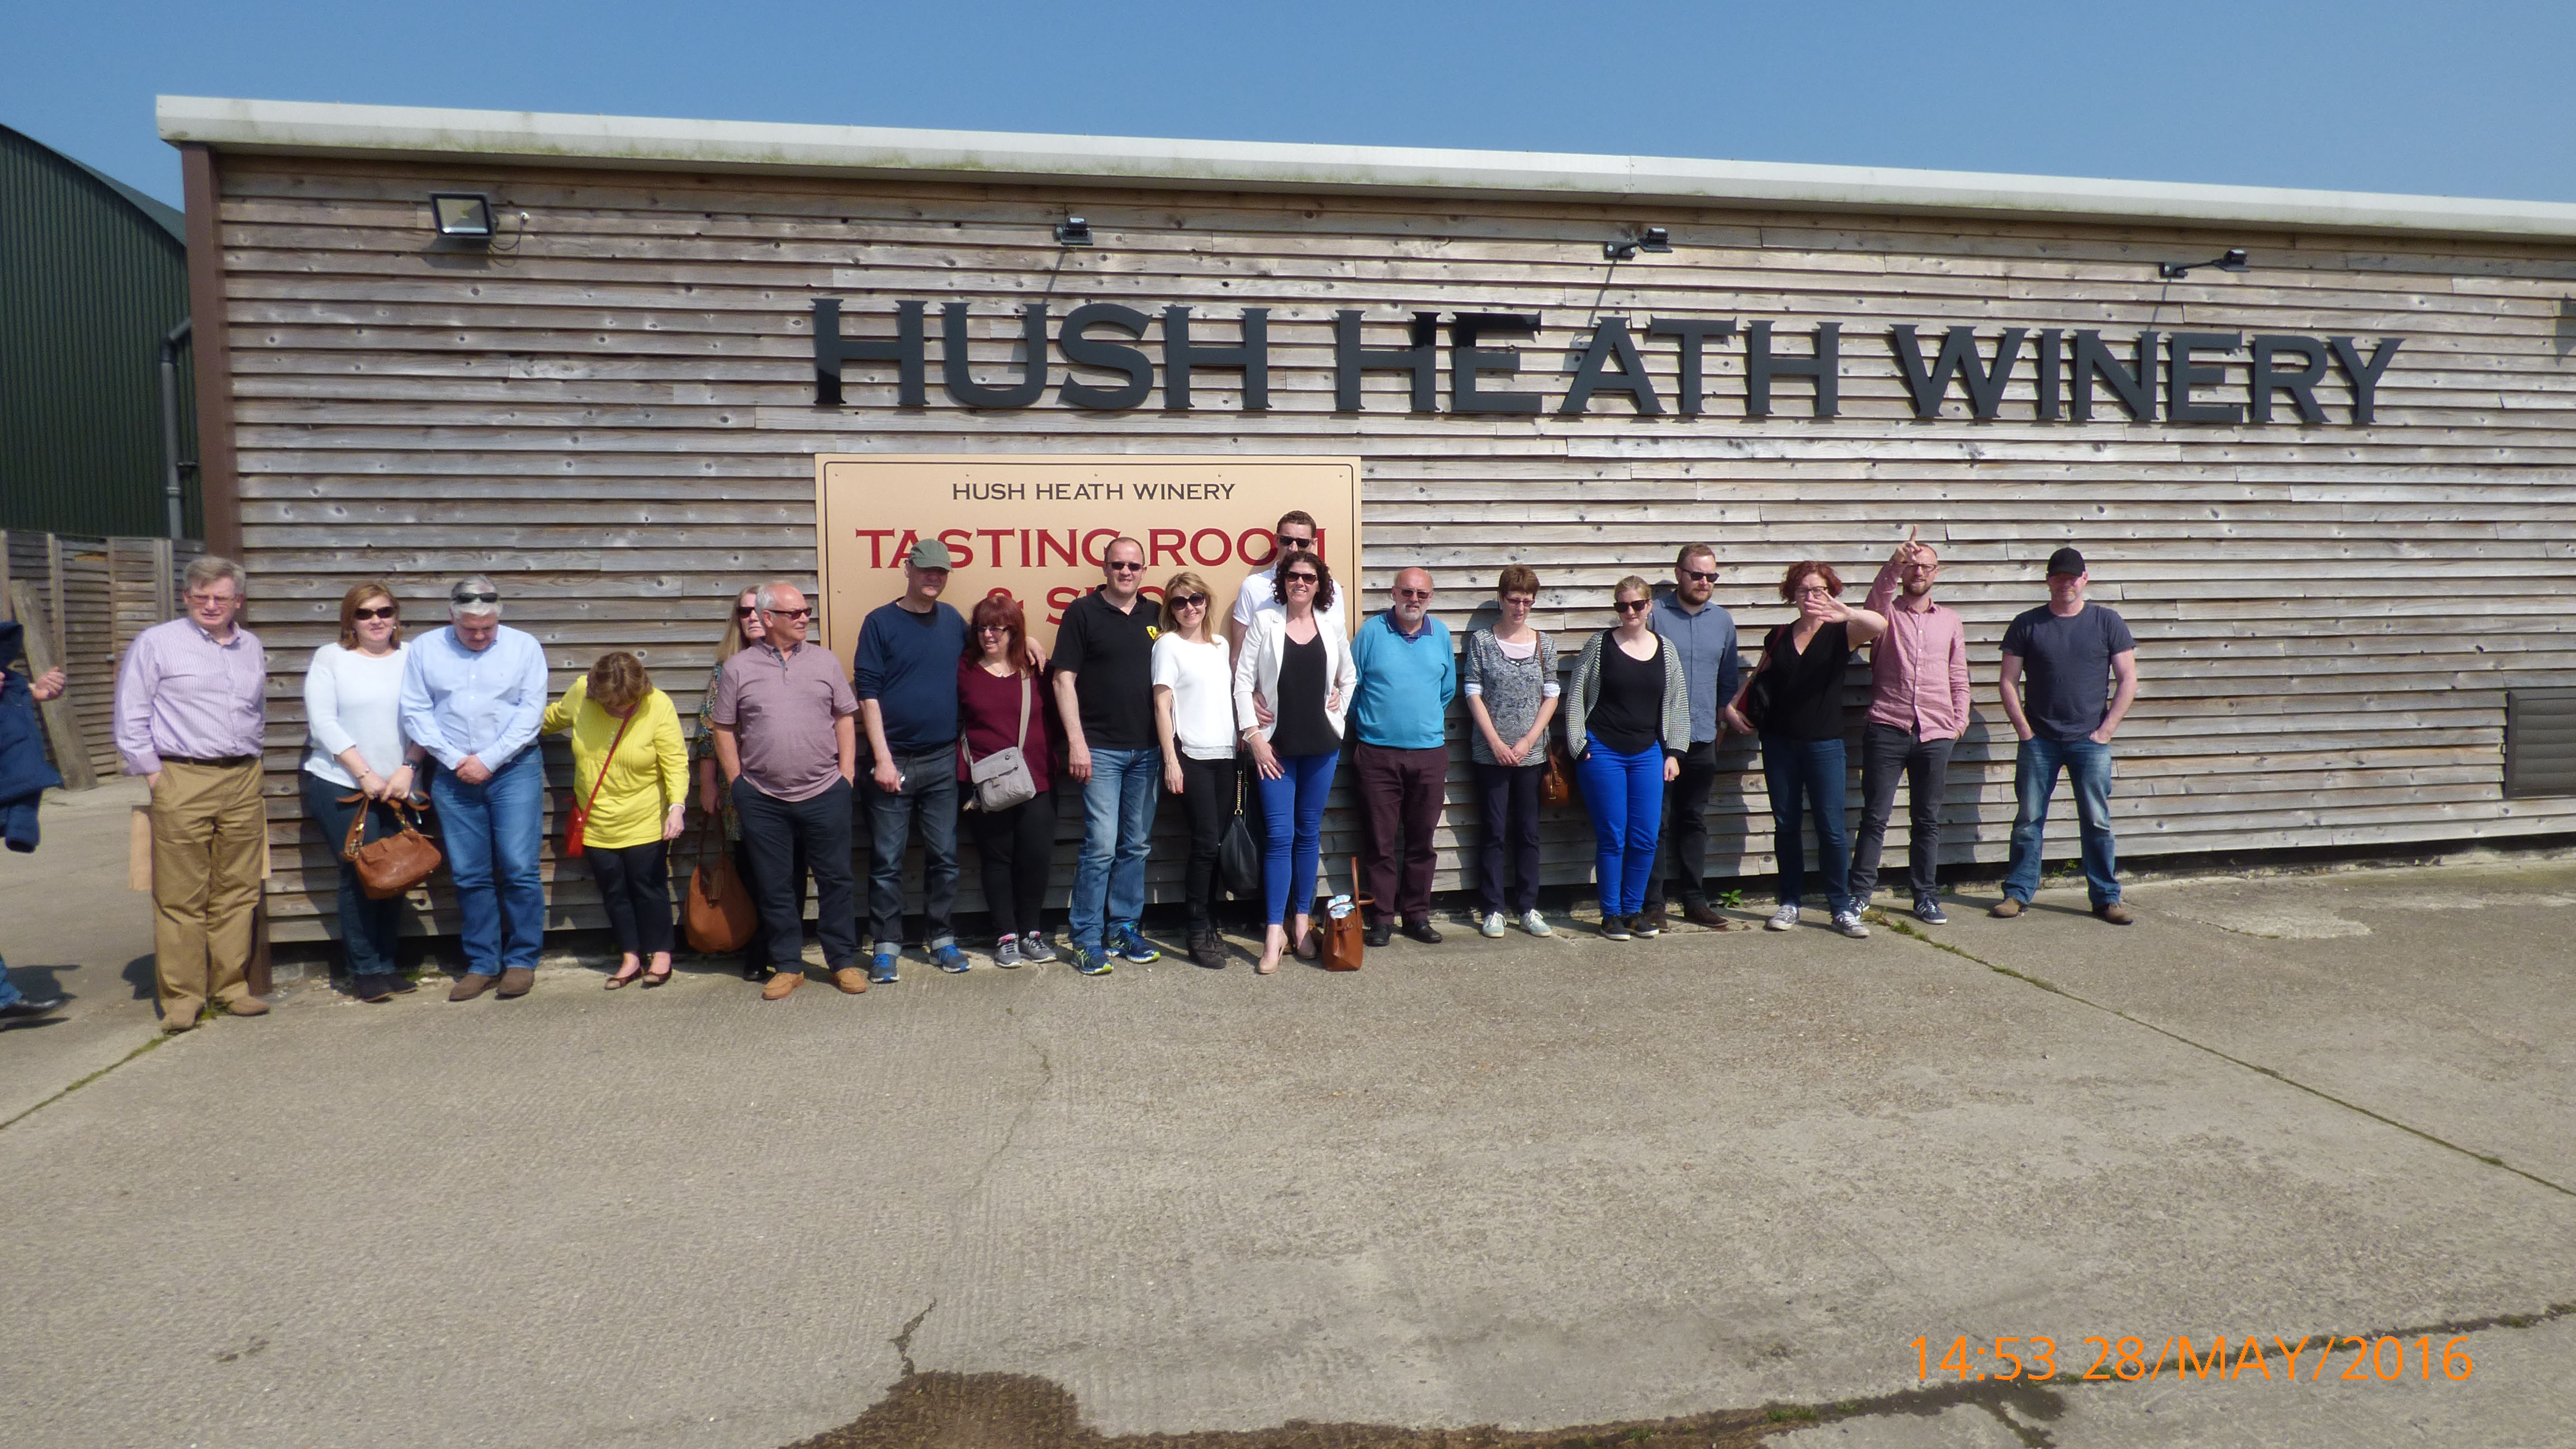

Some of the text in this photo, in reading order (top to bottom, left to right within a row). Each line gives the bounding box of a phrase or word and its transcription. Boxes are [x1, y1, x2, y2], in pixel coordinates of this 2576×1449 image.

[811, 299, 2405, 424] HUSH HEATH WINERY
[953, 482, 1237, 500] HUSH HEATH WINERY
[1148, 528, 1327, 567] ROO
